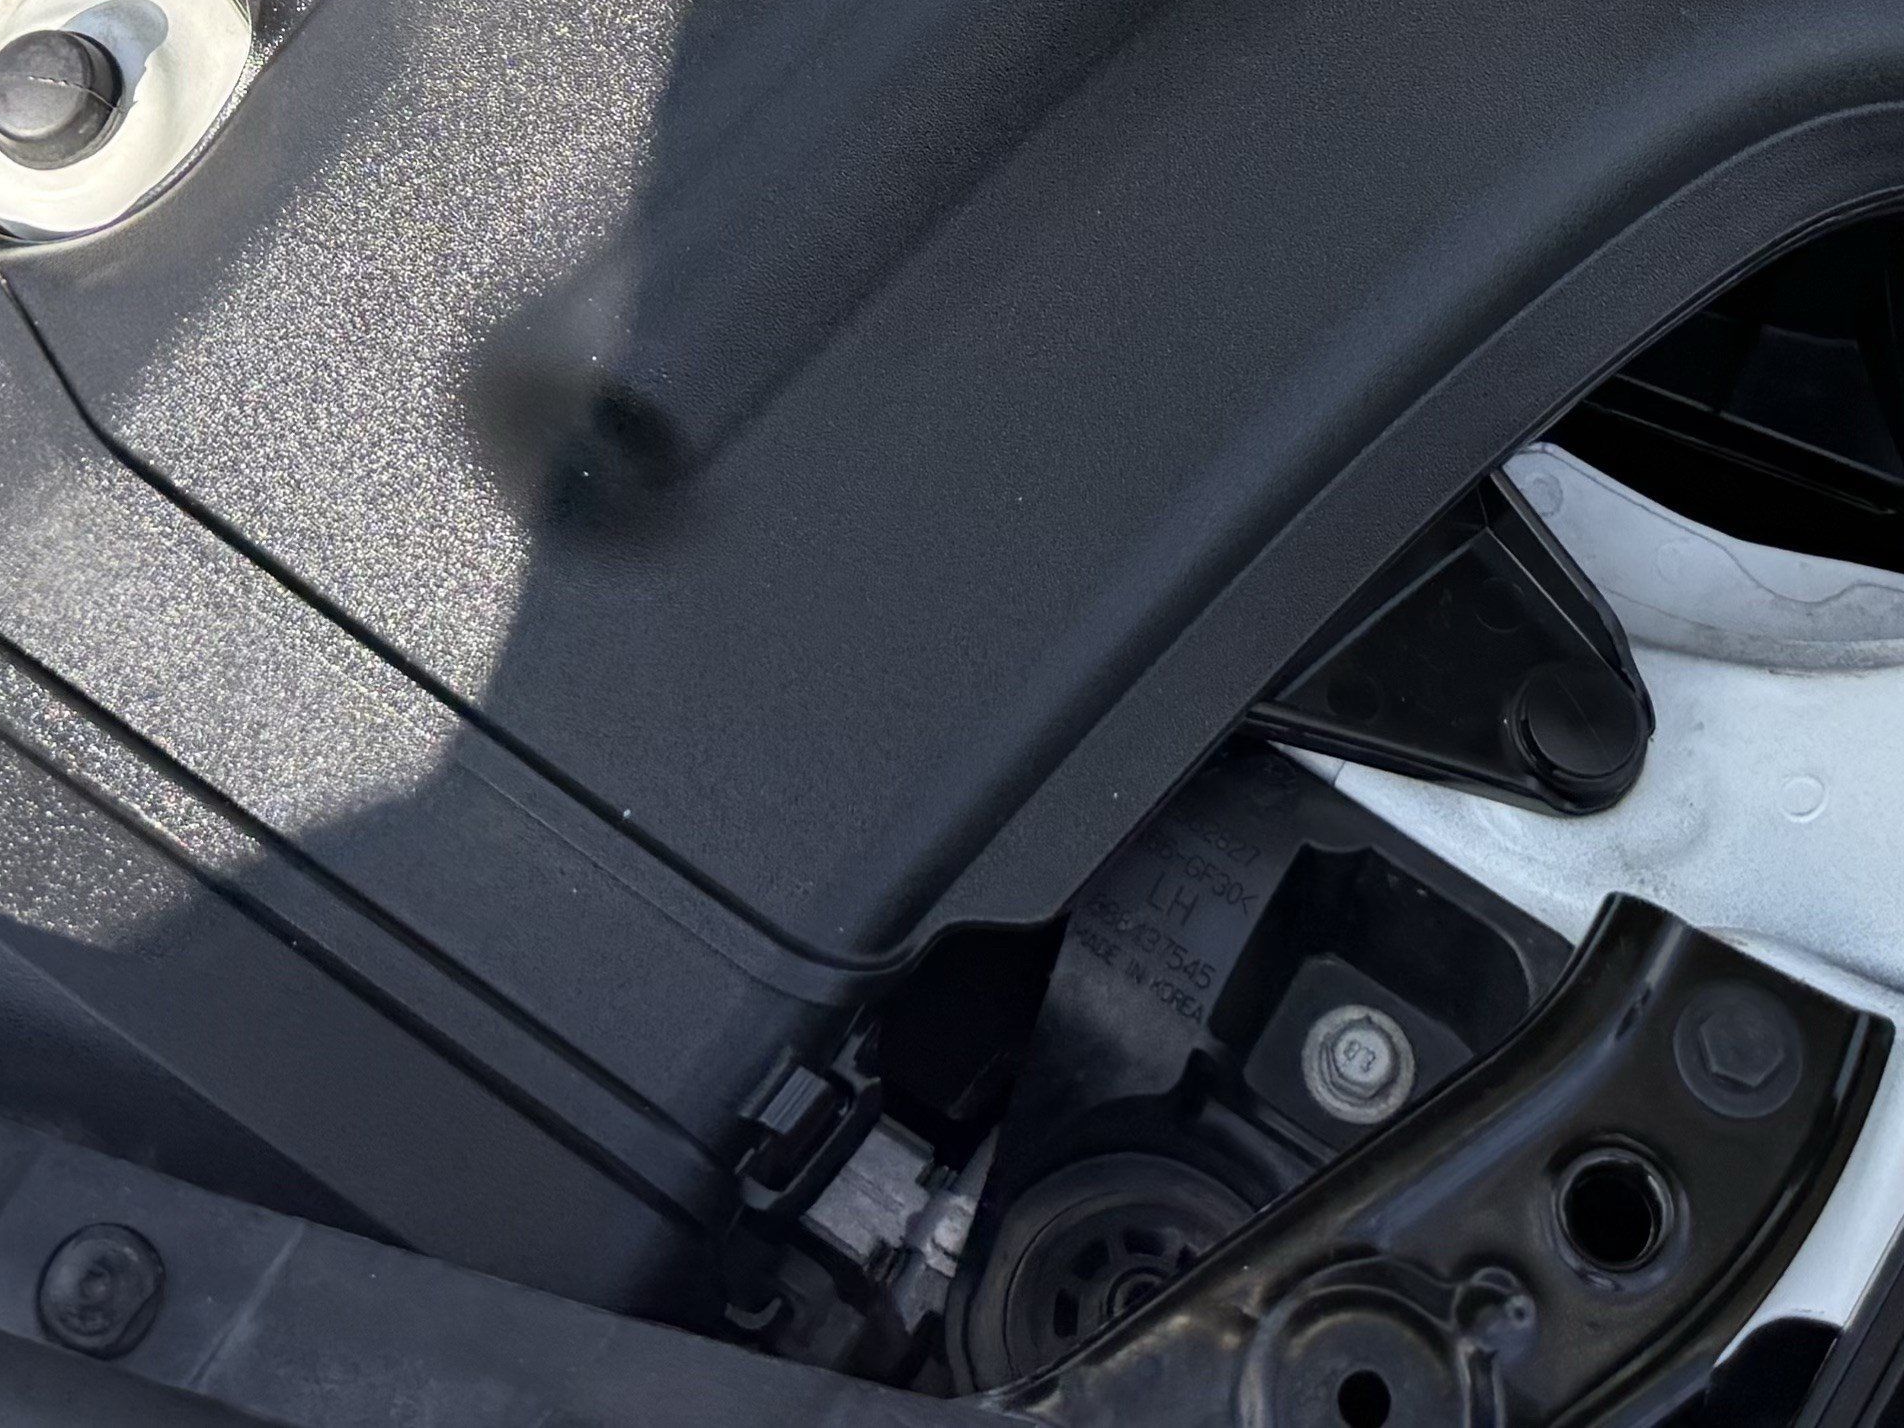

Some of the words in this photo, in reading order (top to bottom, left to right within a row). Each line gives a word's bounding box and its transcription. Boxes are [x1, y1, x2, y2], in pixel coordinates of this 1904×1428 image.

[1145, 870, 1201, 927] LH
[1124, 958, 1149, 985] IN
[1149, 976, 1205, 1027] KOREA
